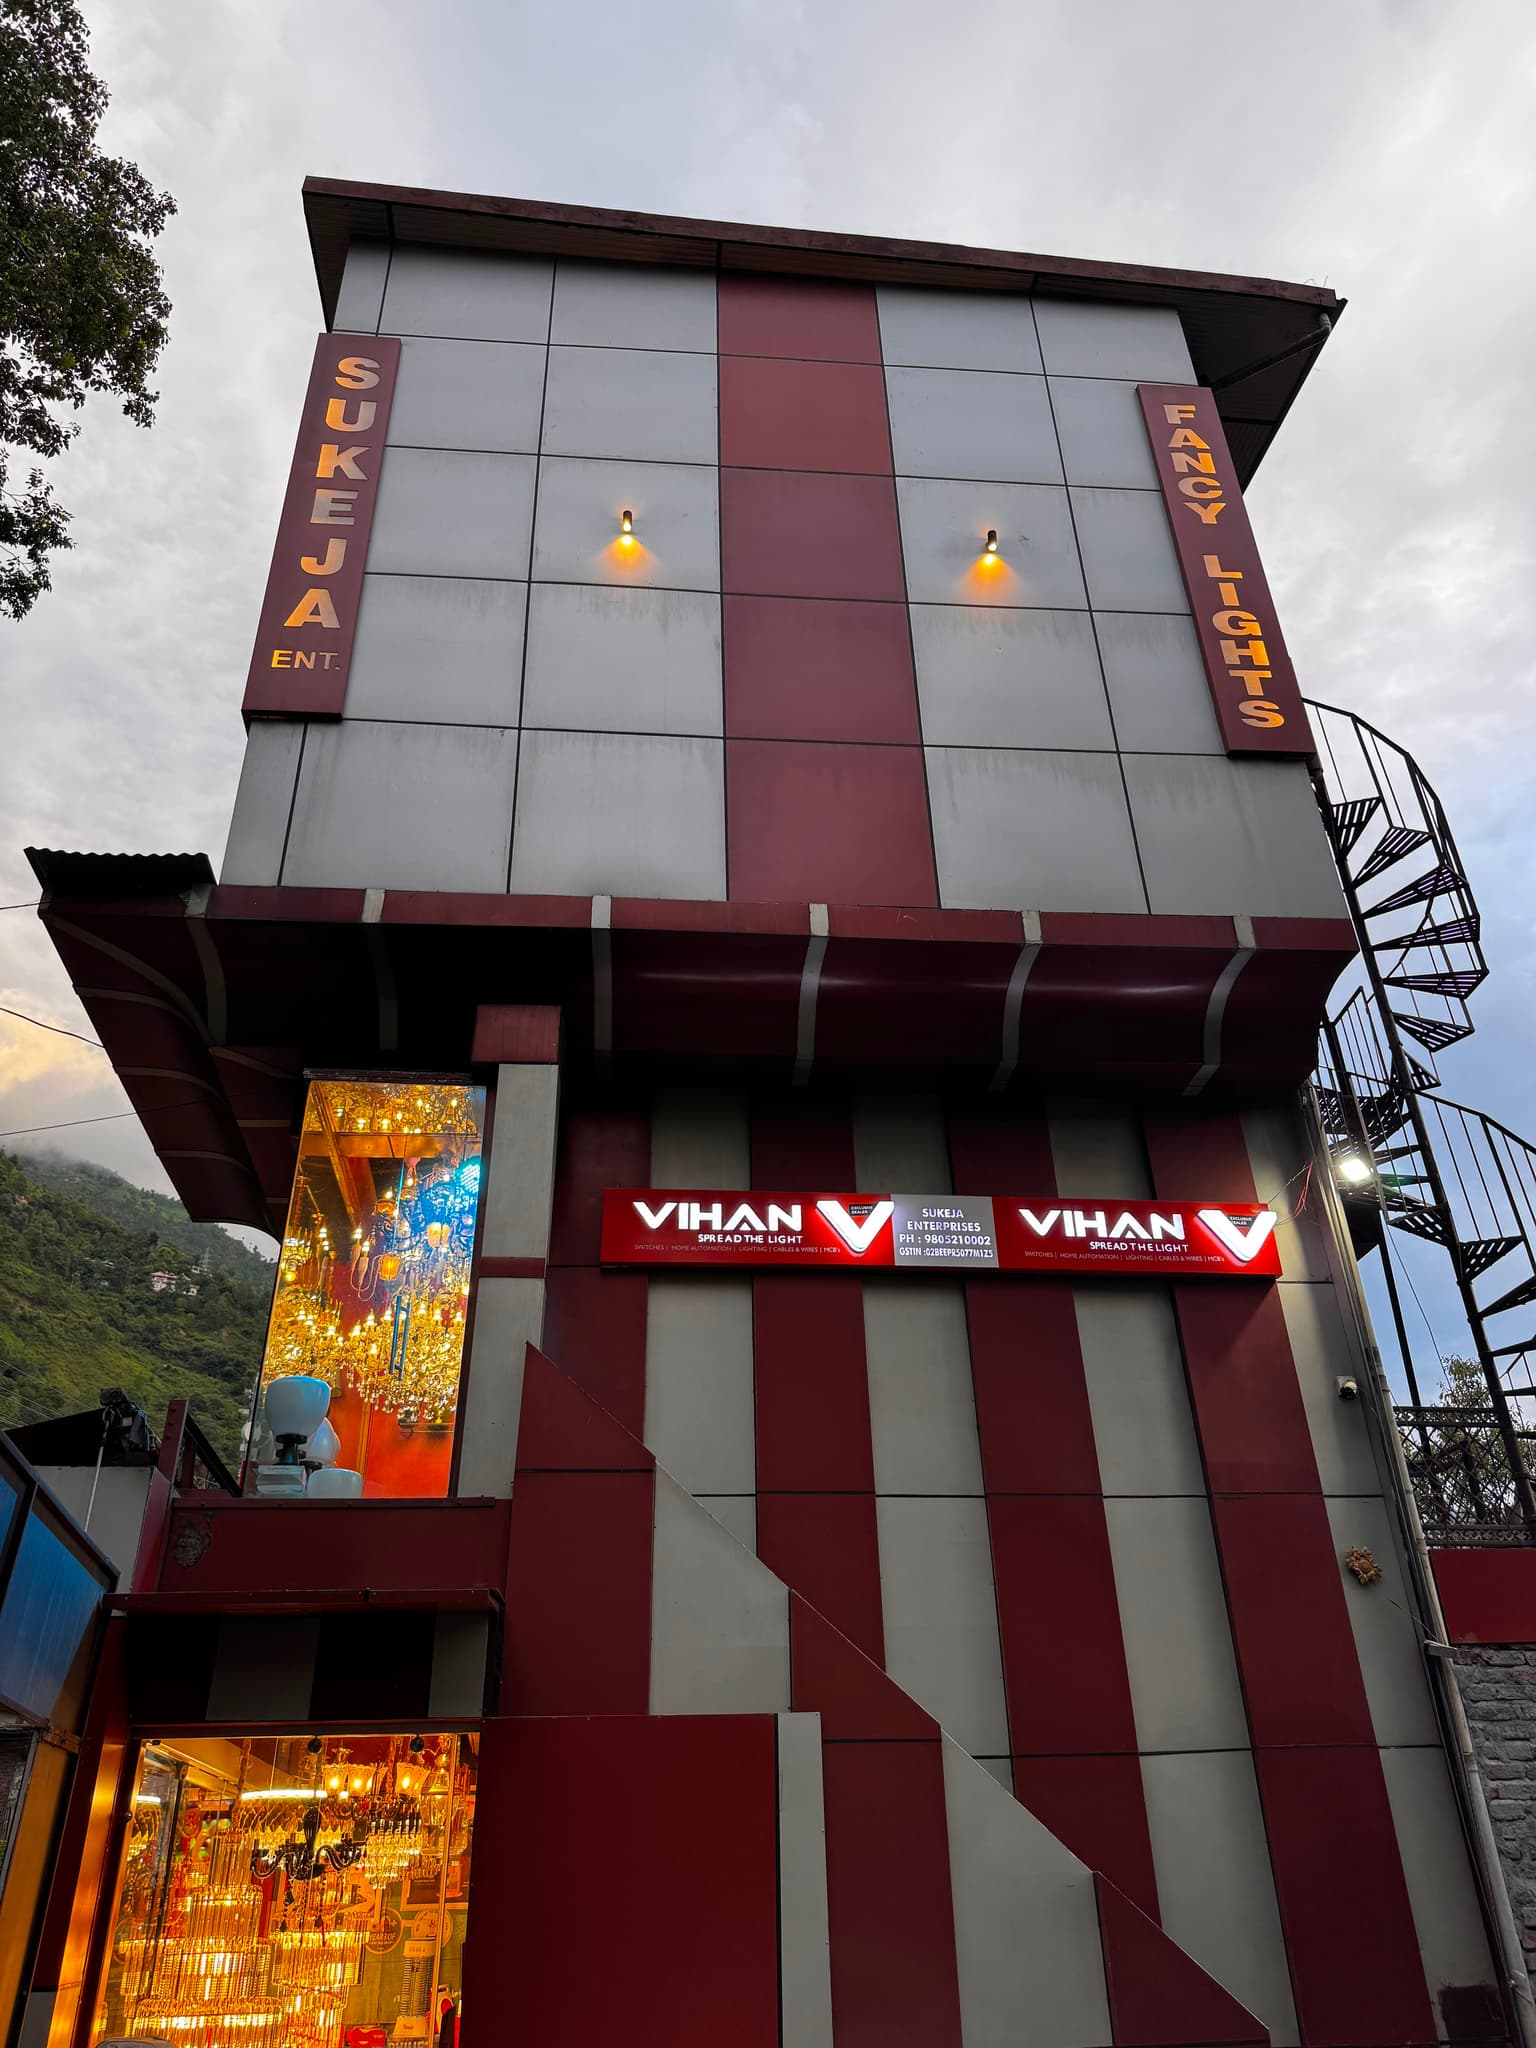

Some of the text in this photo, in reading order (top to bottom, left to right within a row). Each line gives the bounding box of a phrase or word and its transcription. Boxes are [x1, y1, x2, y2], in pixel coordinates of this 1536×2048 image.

[283, 357, 381, 628] SUKEJA
[1163, 404, 1285, 728] FANCY LIGHTS
[271, 649, 342, 670] ENT.
[633, 1201, 801, 1231] VIHAN
[922, 1208, 964, 1218] SUKEJA
[907, 1221, 981, 1231] ENTERPRISES
[1018, 1208, 1186, 1240] VIHAN
[698, 1234, 803, 1244] SPREAD THE LIGHT
[924, 1234, 992, 1245] 9805210002
[899, 1247, 922, 1256] GSTIN
[1089, 1241, 1189, 1253] SPREAD THE LIGHT
[1024, 1250, 1054, 1258] SWITCHES
